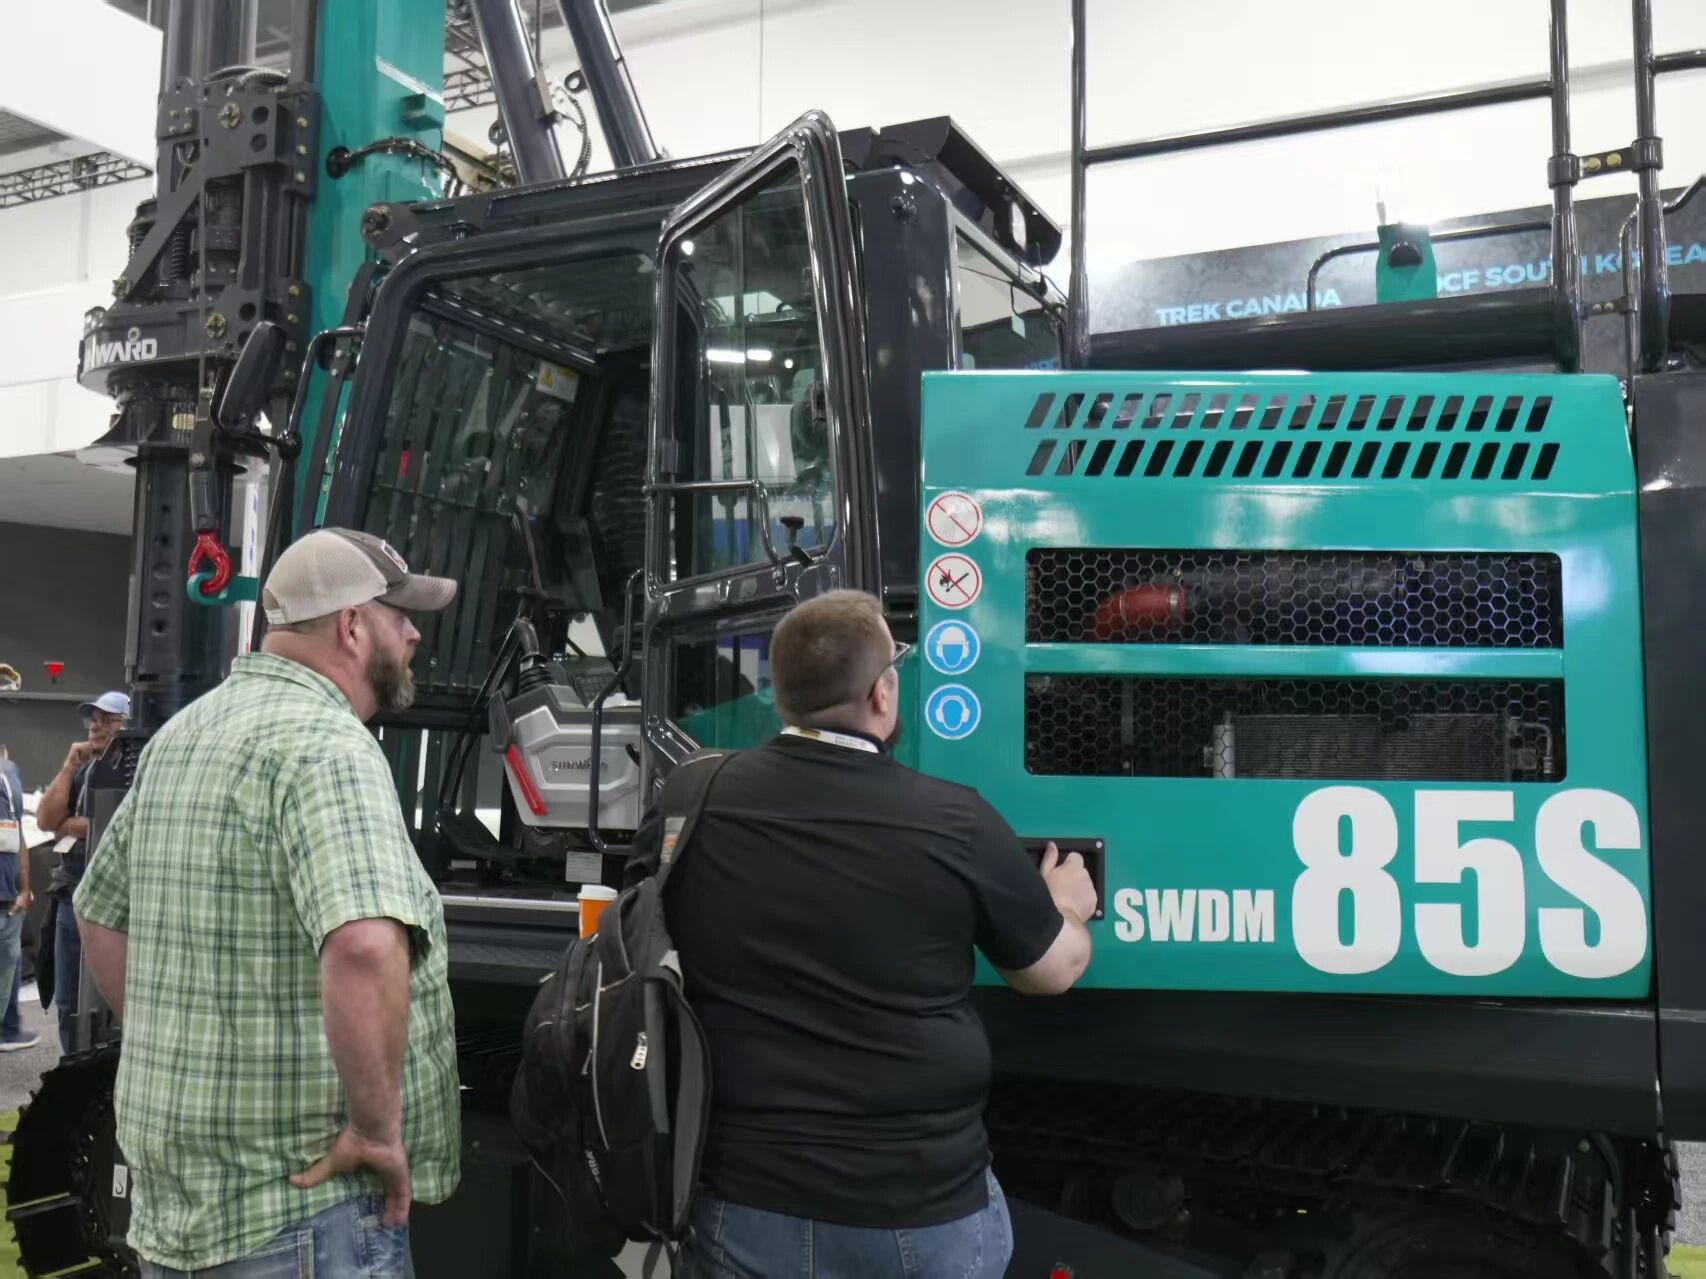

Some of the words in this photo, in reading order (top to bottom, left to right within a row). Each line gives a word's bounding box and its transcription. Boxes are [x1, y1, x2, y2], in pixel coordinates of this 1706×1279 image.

[1156, 302, 1222, 327] TREK
[1114, 888, 1275, 943] SWDM
[1292, 785, 1648, 979] 85S
